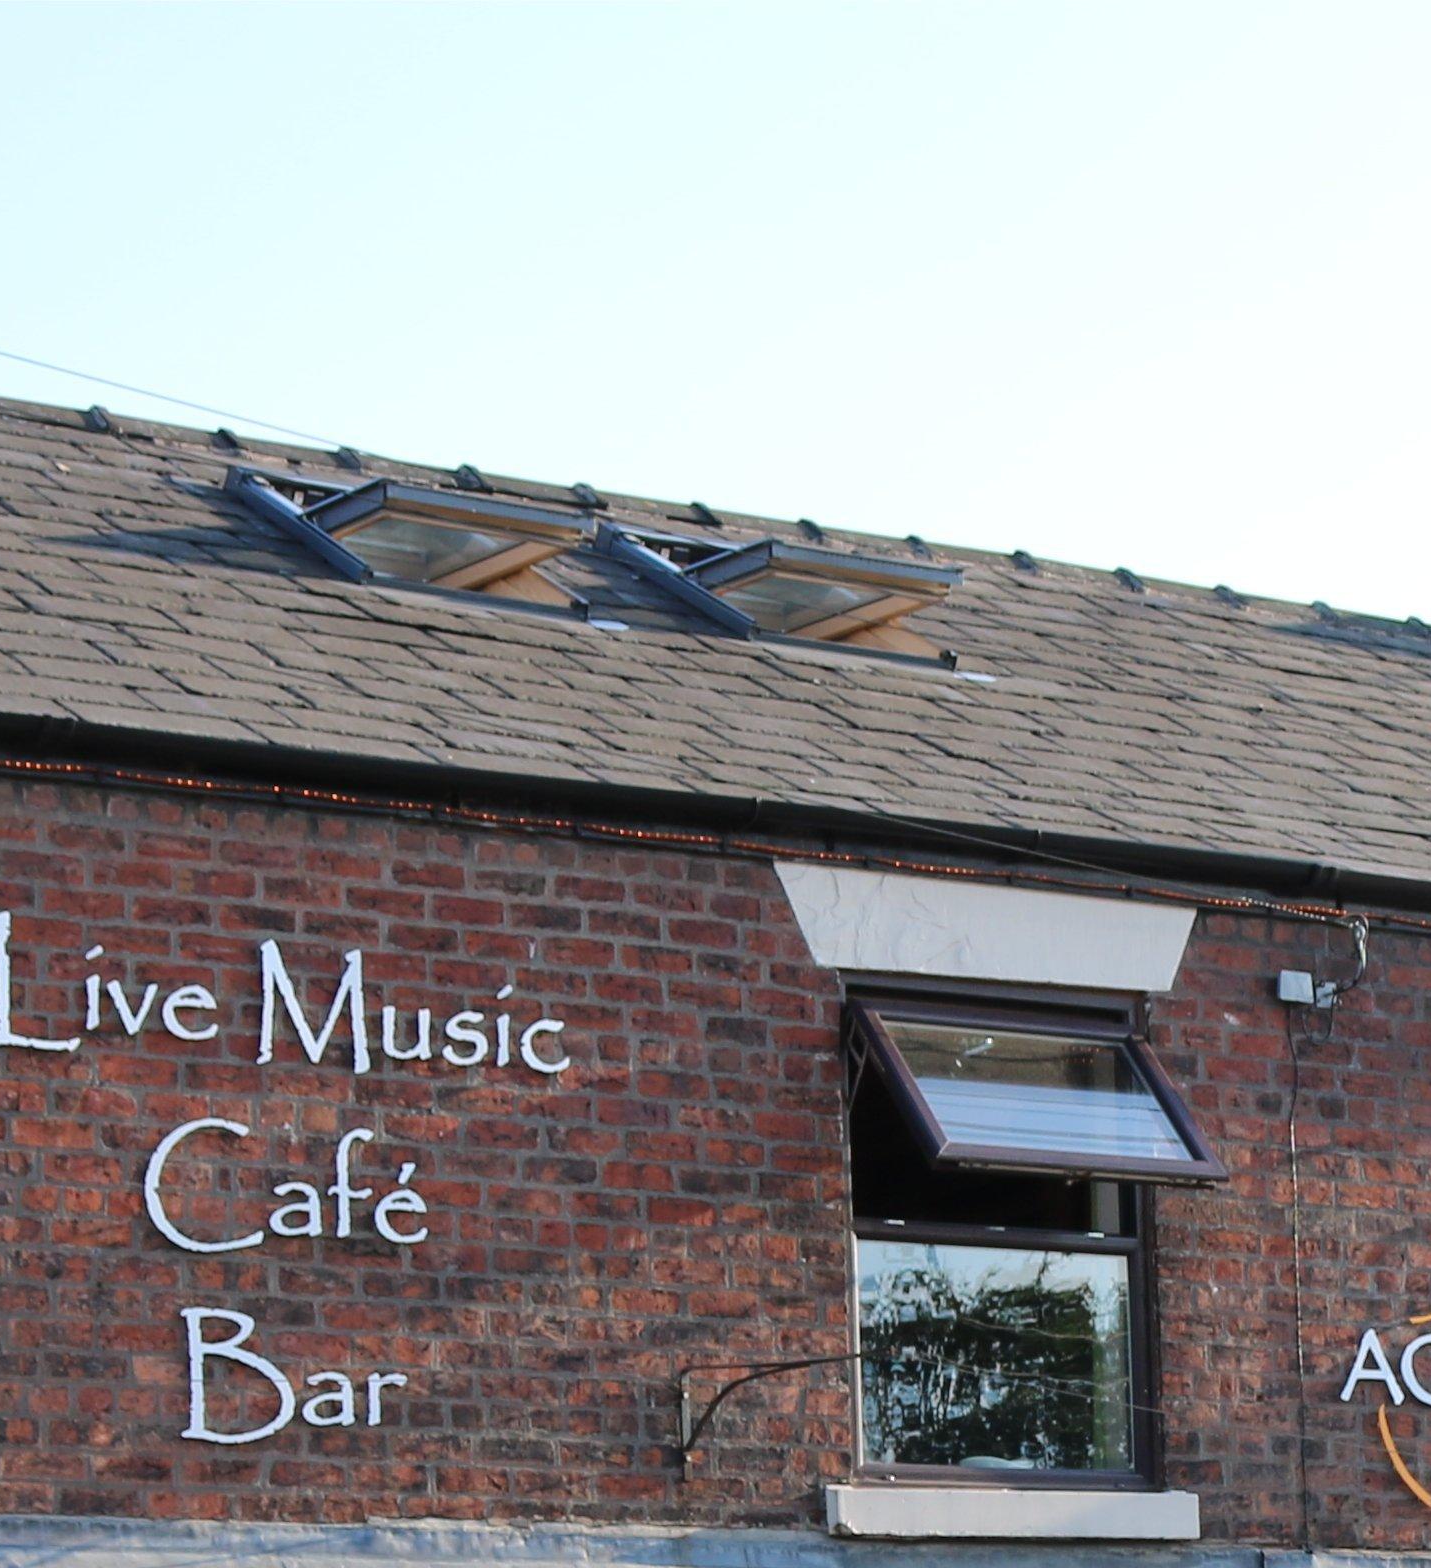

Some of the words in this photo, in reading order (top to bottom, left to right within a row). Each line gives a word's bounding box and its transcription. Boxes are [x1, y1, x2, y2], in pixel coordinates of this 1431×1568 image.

[256, 938, 570, 1075] Music
[144, 1117, 429, 1253] Café
[181, 1306, 408, 1445] Bar
